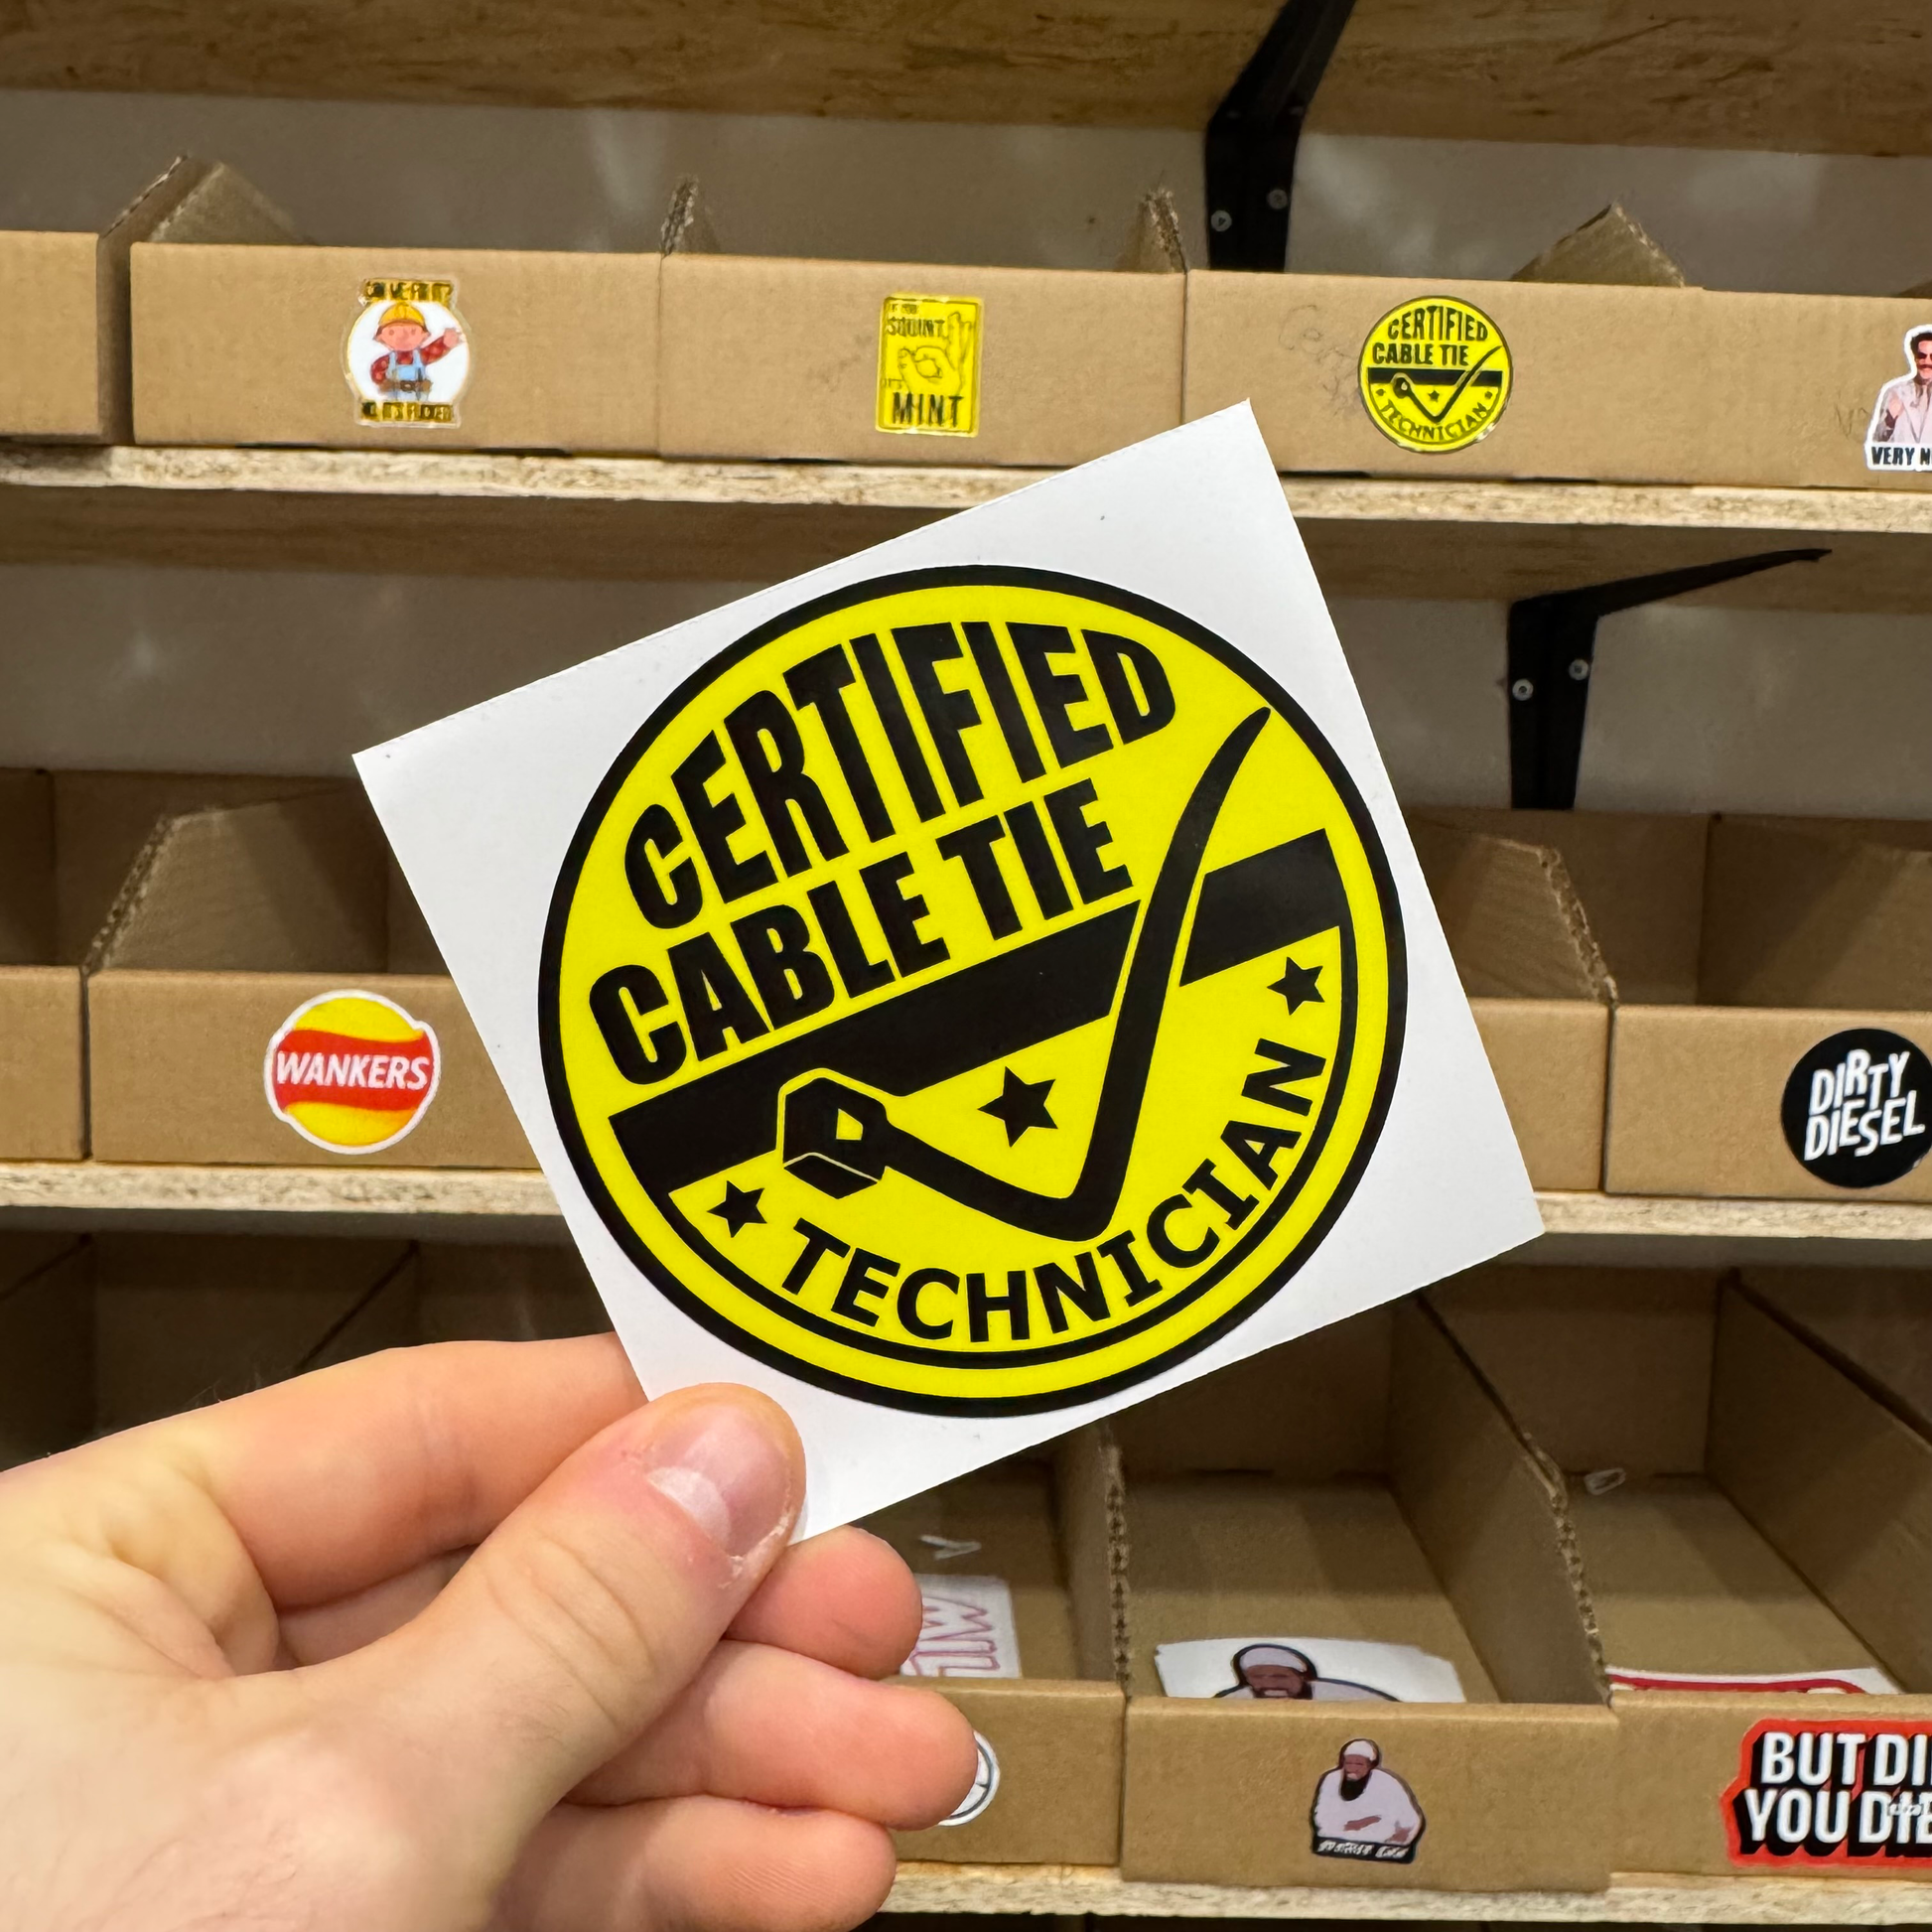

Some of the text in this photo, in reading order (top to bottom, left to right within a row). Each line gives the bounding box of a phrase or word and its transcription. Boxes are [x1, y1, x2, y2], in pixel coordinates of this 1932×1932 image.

[1387, 306, 1489, 342] CERTIFIED
[1372, 343, 1470, 366] CABLE TIE
[893, 391, 965, 428] MINT
[1380, 398, 1491, 441] TECHNICIAN
[1871, 446, 1916, 467] VERY
[624, 621, 1175, 929] CERTIFIED
[590, 778, 1133, 1084] CABLE TIE
[276, 1050, 431, 1090] WANKERS
[1808, 1048, 1911, 1117] DIRTY
[1803, 1090, 1926, 1162] DIESEL
[781, 1038, 1326, 1342] TECHNICIAN
[1759, 1731, 1866, 1786] BUT
[1743, 1787, 1851, 1845] YOU
